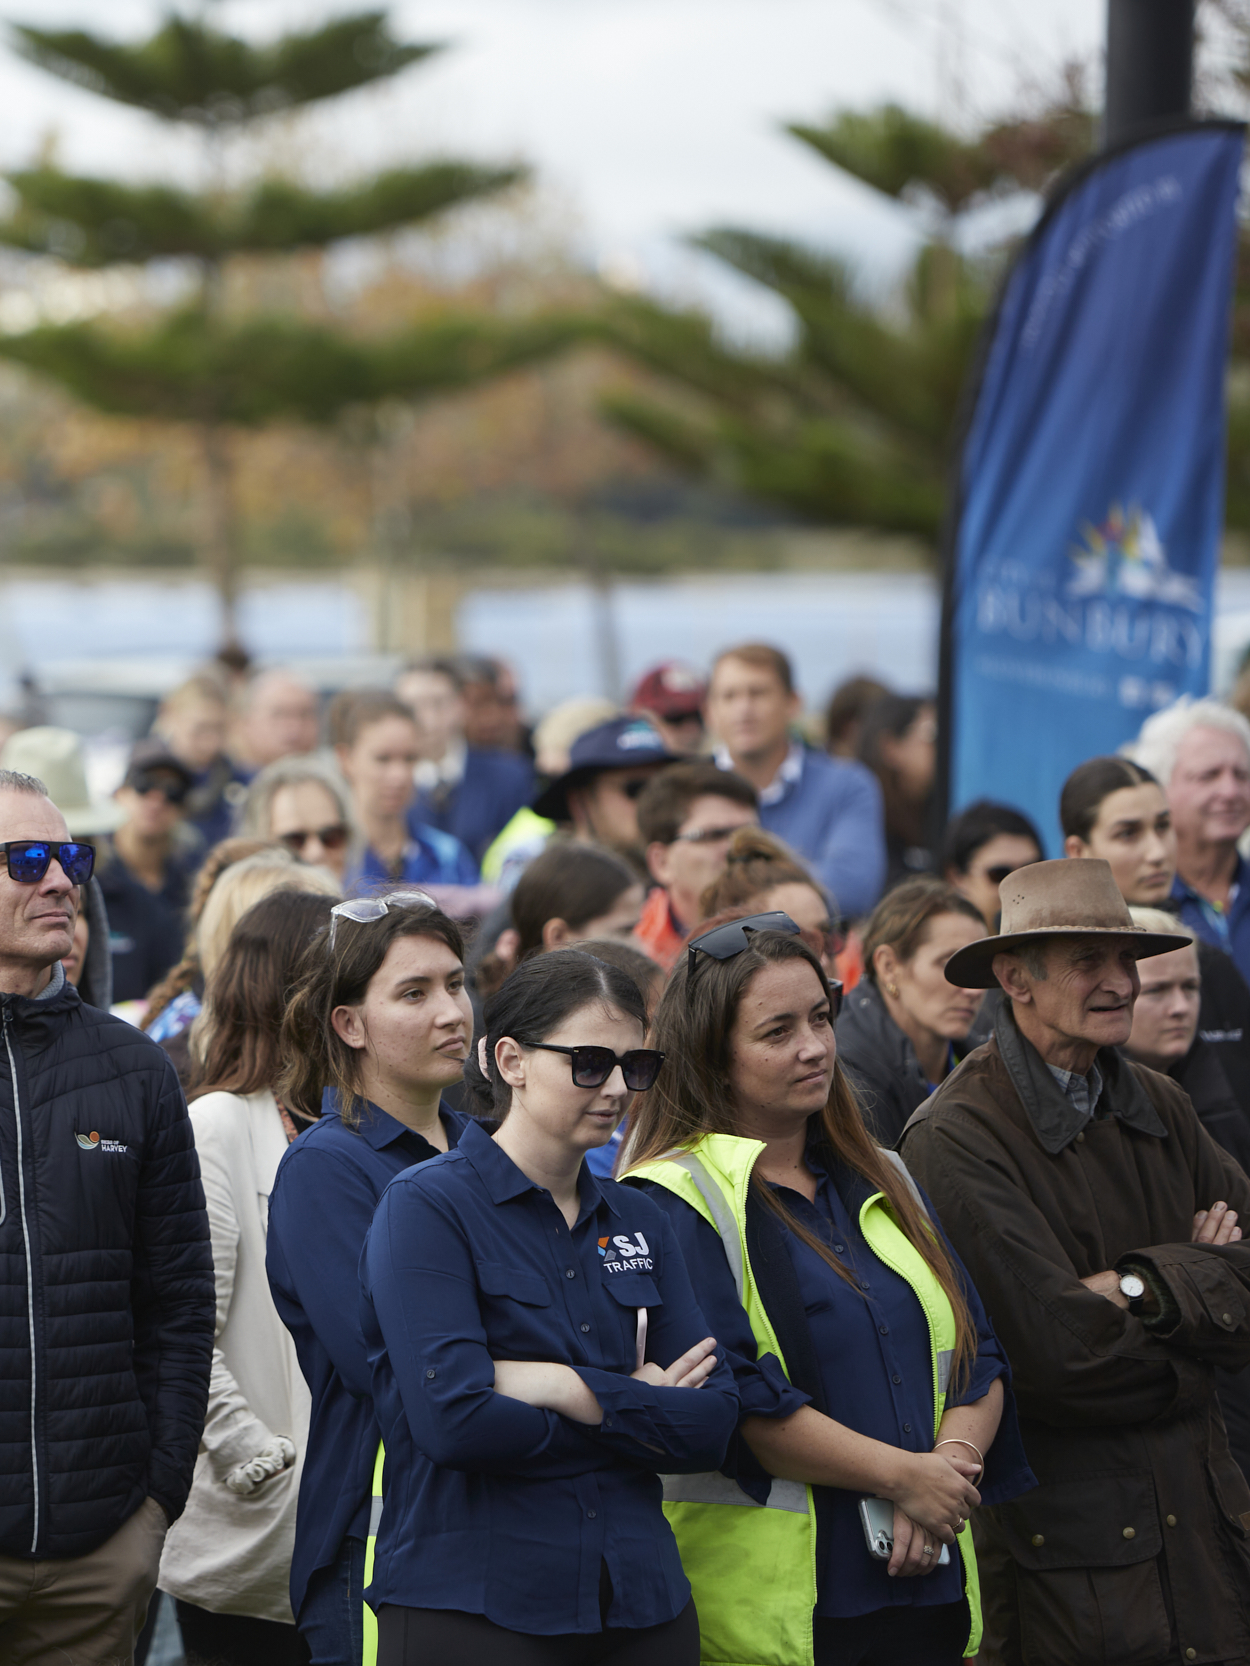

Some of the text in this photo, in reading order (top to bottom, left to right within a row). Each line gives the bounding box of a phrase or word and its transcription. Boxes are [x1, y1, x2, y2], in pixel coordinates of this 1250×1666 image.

[976, 585, 1204, 671] BUNBURY
[101, 1144, 128, 1153] HARVEY
[612, 1231, 650, 1257] SJ
[603, 1257, 653, 1274] TRAFFIC
